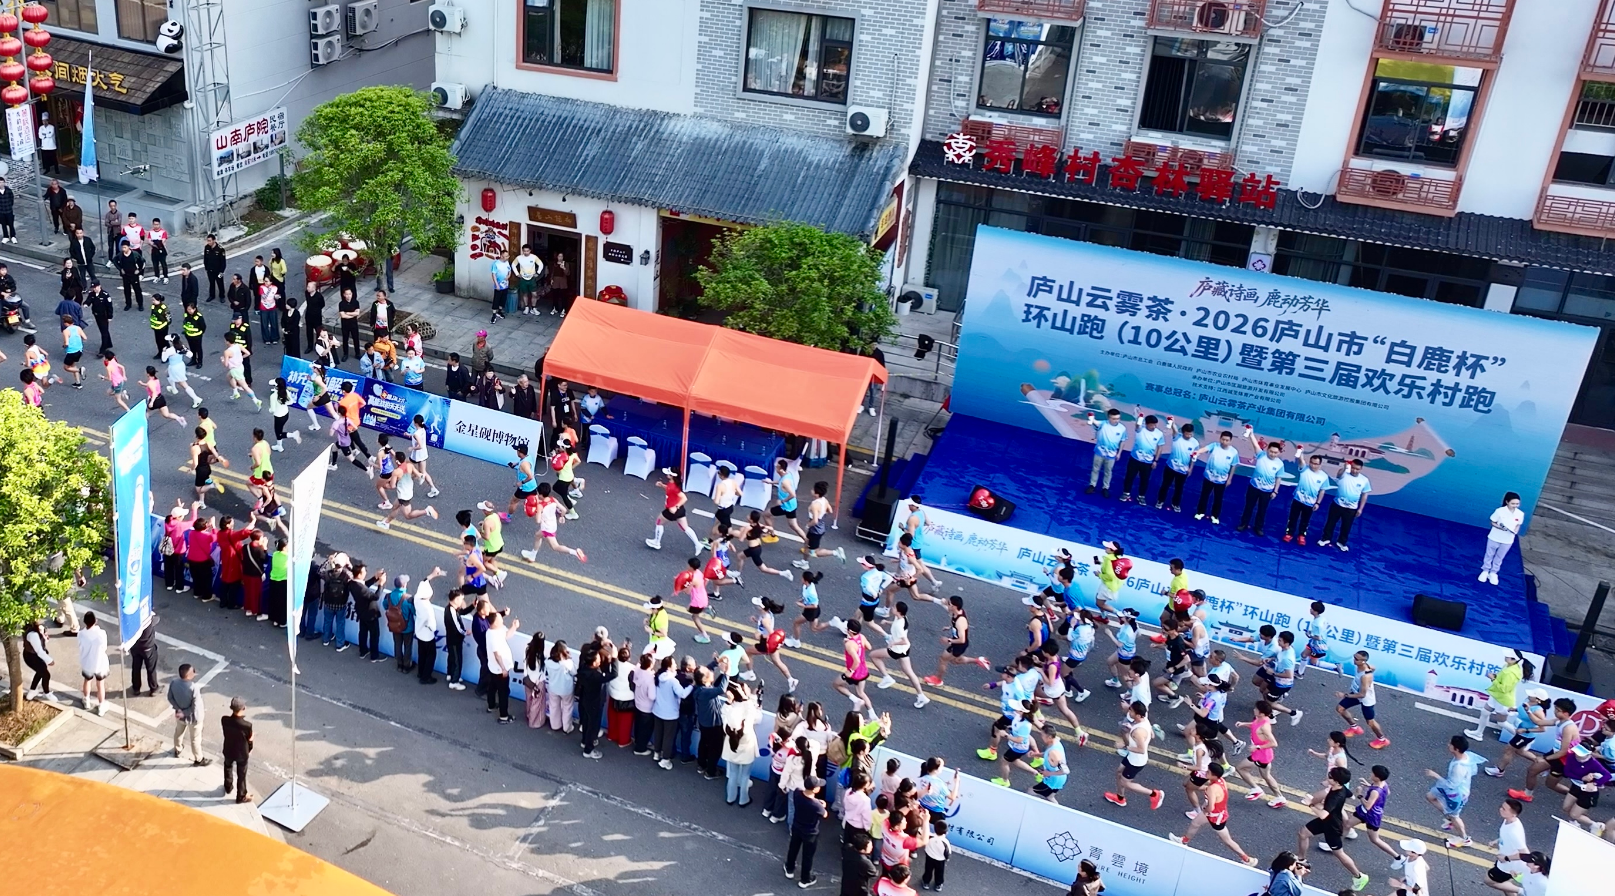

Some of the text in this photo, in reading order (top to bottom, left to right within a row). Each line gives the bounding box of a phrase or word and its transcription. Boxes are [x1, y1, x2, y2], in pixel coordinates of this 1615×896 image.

[37, 62, 129, 95] 间烟火气
[216, 117, 269, 151] 山南庐院
[982, 138, 1281, 210] 秀峰村杏林驿站
[1189, 276, 1331, 321] 庐藏诗画 鹿动芳华
[963, 532, 1009, 553] 鹿动芳华
[1117, 870, 1146, 885] HEIGHT
